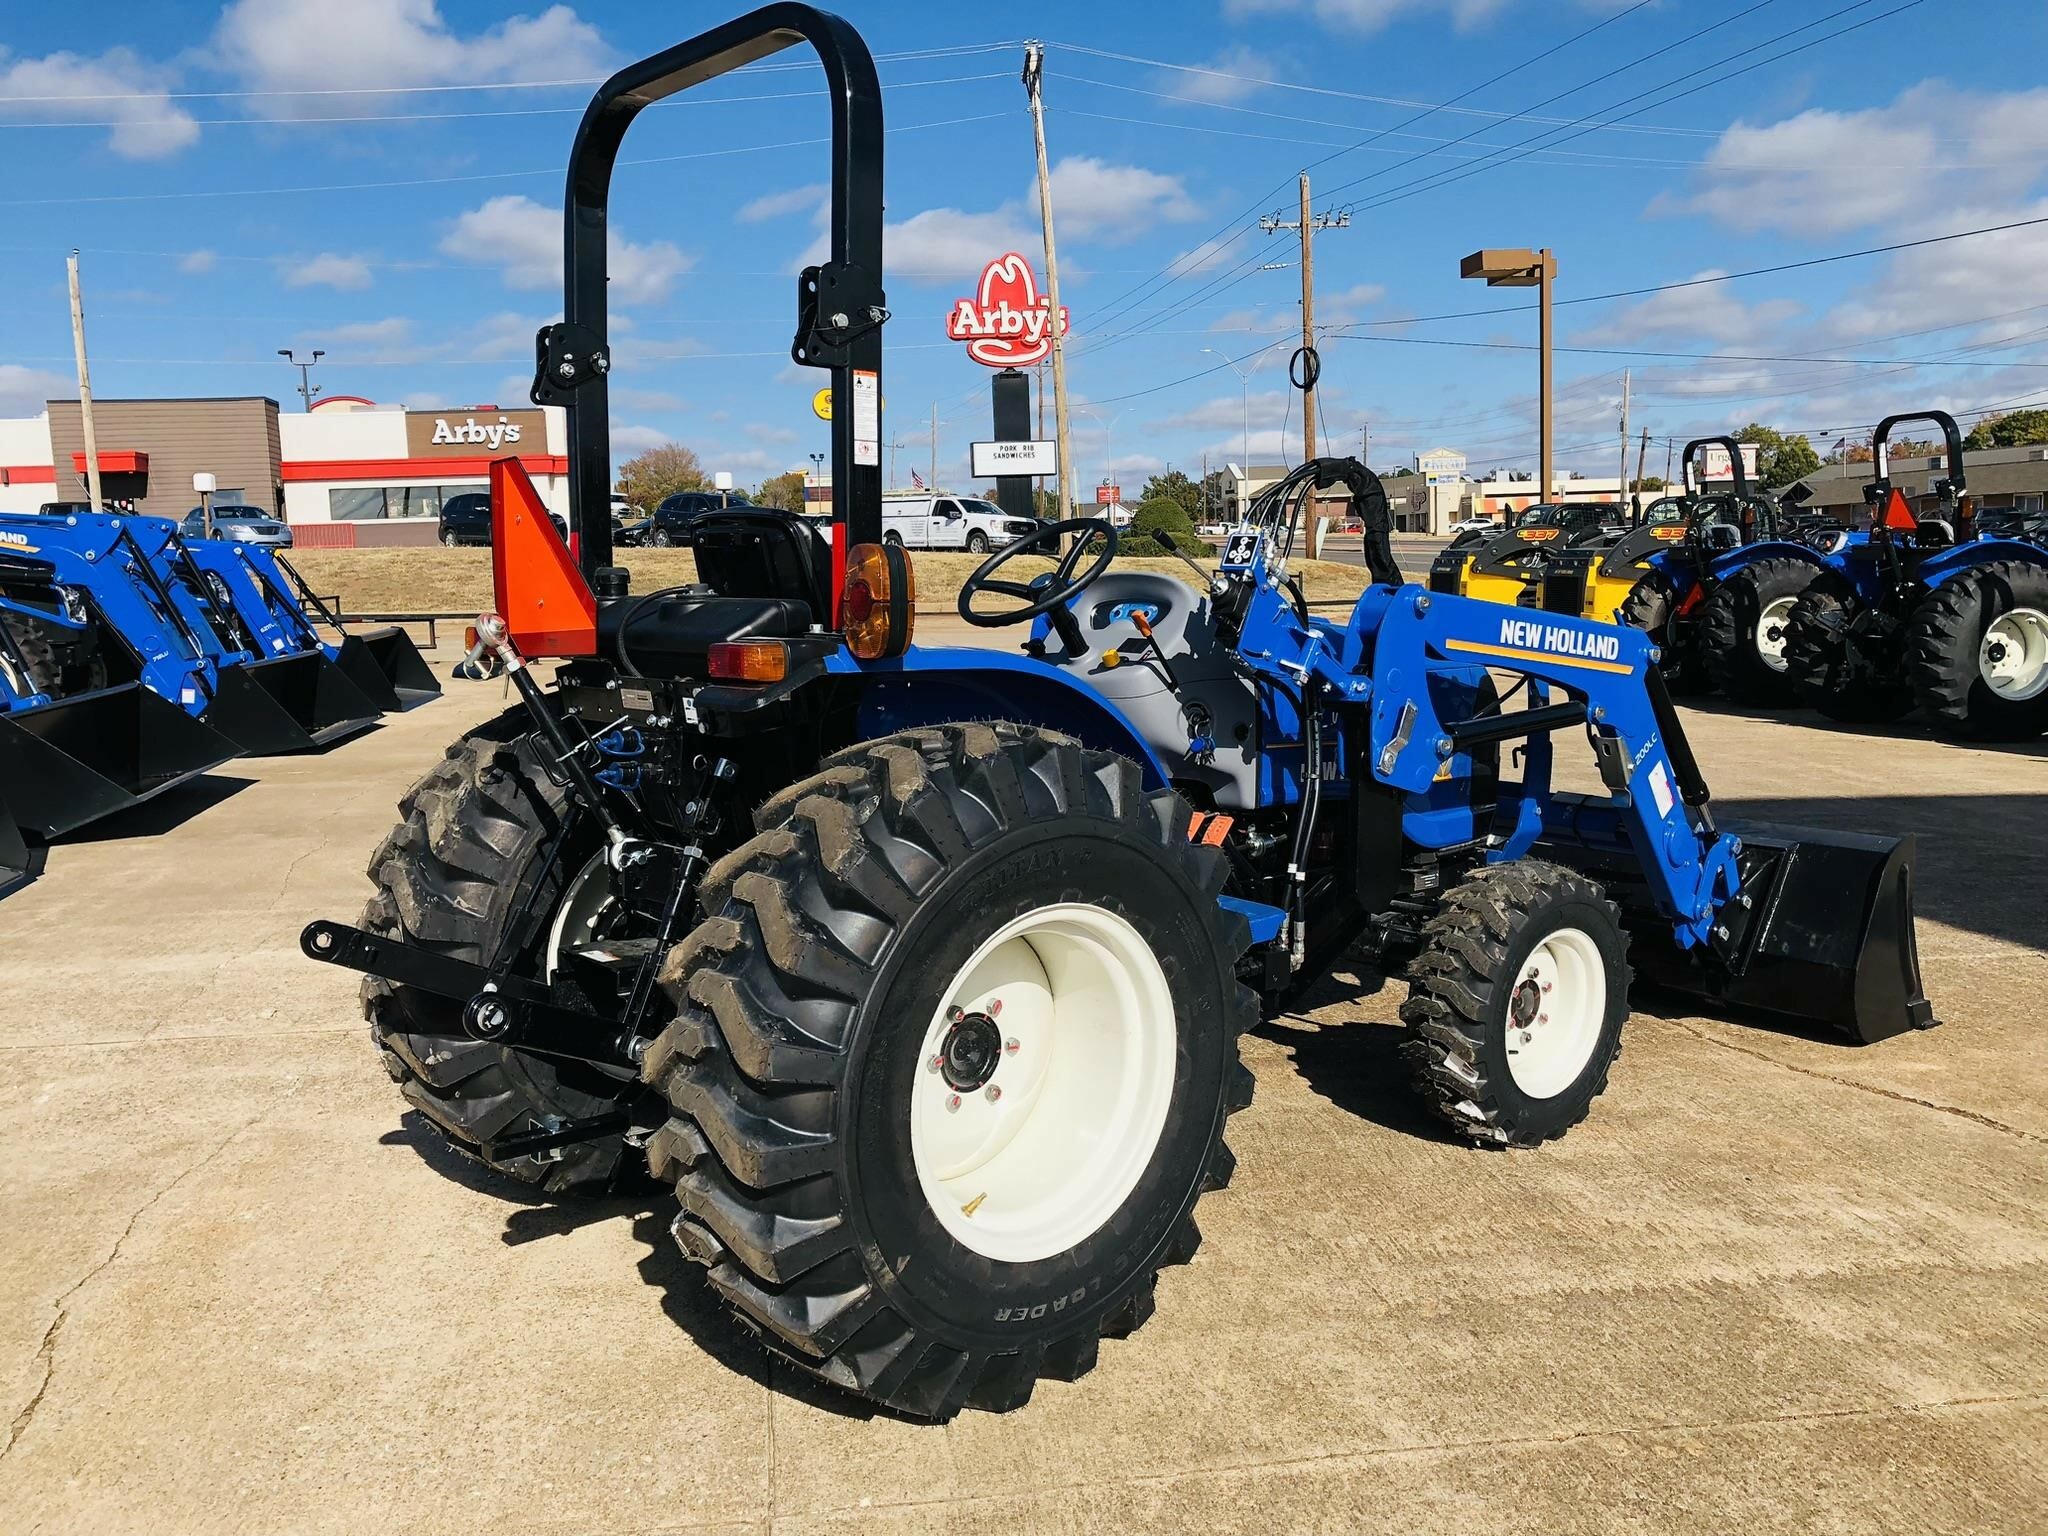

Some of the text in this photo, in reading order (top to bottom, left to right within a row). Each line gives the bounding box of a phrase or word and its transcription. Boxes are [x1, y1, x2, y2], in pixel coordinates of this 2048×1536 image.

[431, 416, 521, 450] Arby's
[1516, 528, 1560, 541] C337
[1649, 527, 1687, 541] C33
[1500, 618, 1619, 661] NEW HOLLAND
[1634, 732, 1658, 766] 200LC
